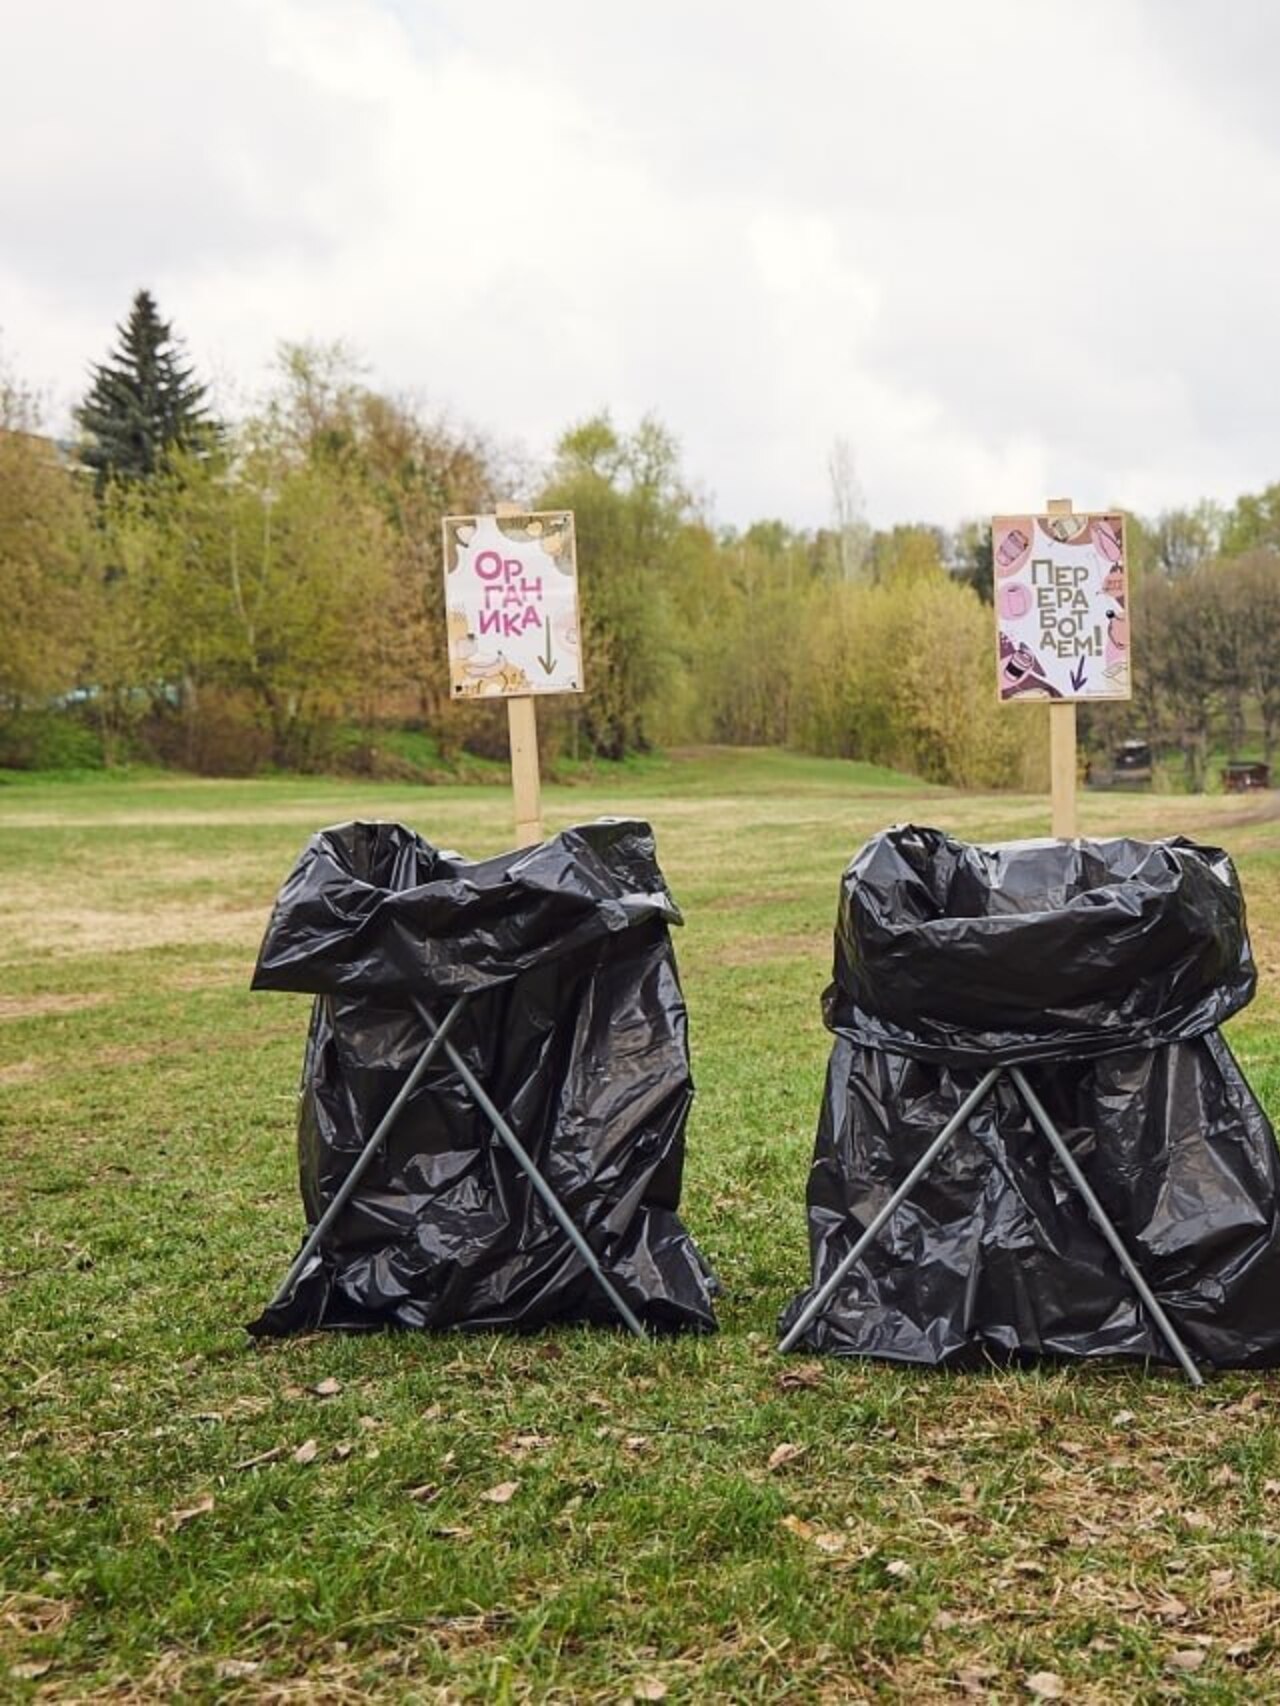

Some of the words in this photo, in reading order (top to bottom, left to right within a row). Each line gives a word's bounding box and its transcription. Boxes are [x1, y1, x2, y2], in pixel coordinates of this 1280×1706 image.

[1031, 559, 1089, 588] ПЕР
[484, 576, 542, 610] ГАН
[1037, 588, 1089, 609] ЕРА
[479, 604, 542, 637] ИКА
[1039, 609, 1089, 638] БОТ
[1039, 625, 1103, 658] АЕМ!
